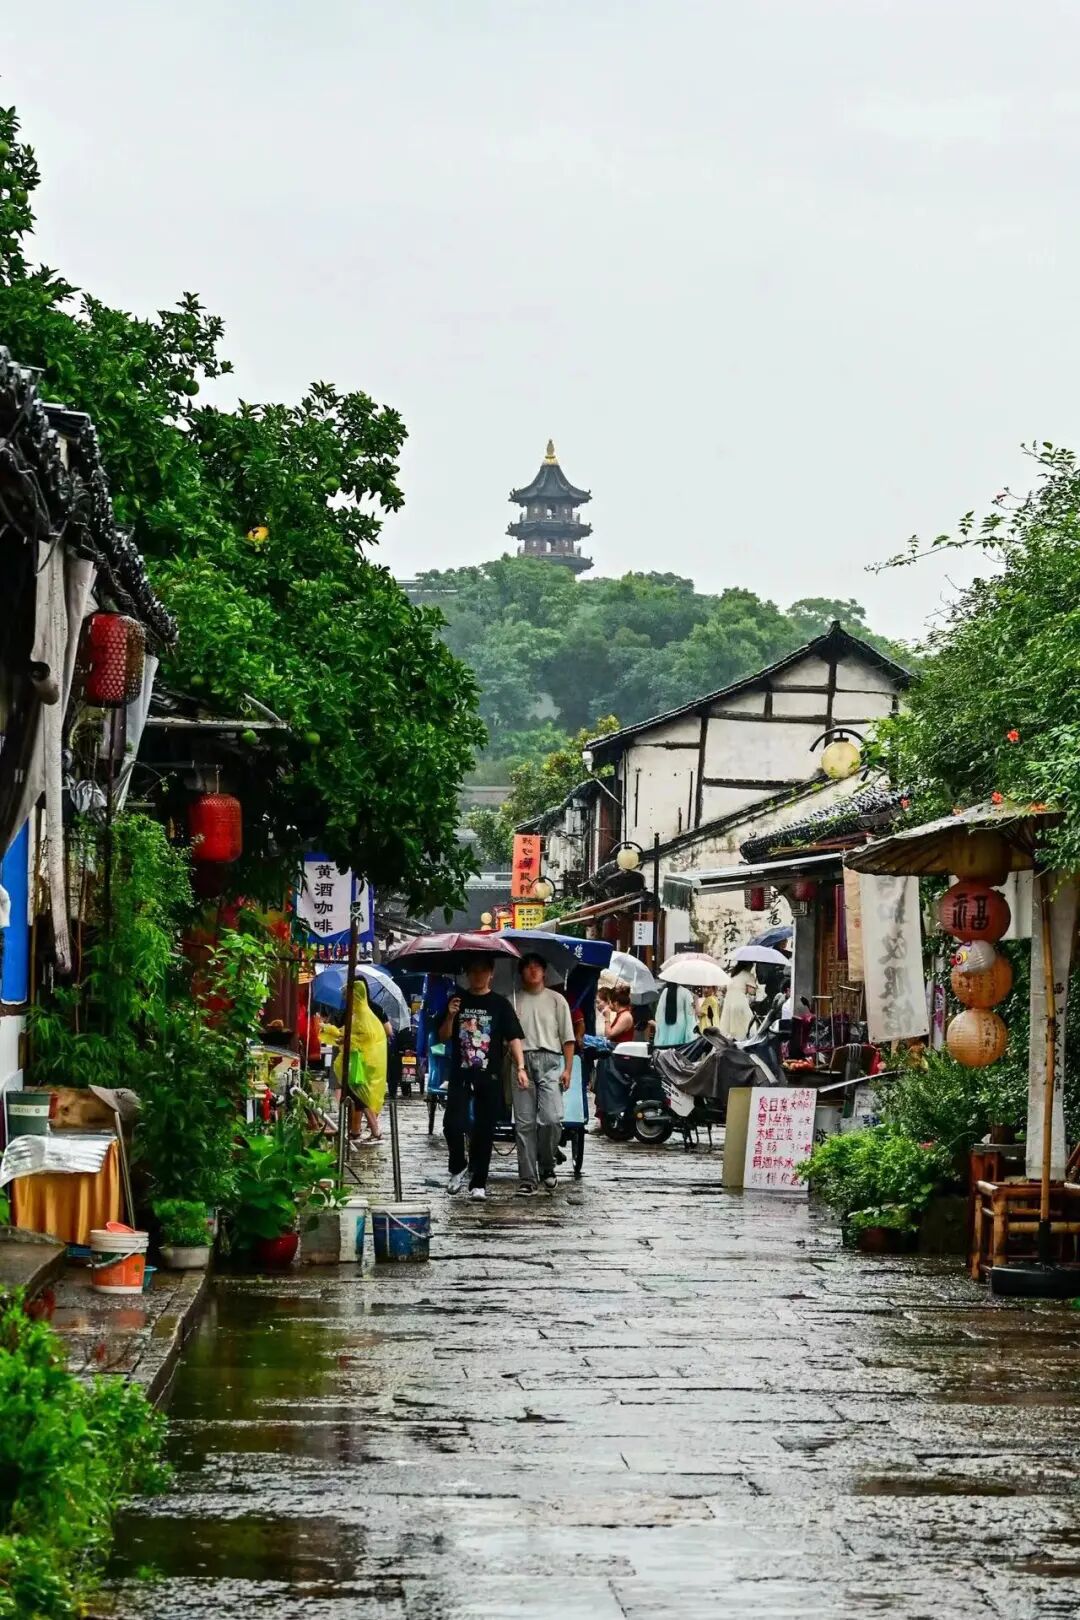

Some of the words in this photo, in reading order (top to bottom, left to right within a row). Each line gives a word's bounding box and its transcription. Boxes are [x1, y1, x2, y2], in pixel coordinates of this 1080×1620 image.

[314, 864, 334, 933] 黄酒咖啡
[952, 893, 990, 931] 福
